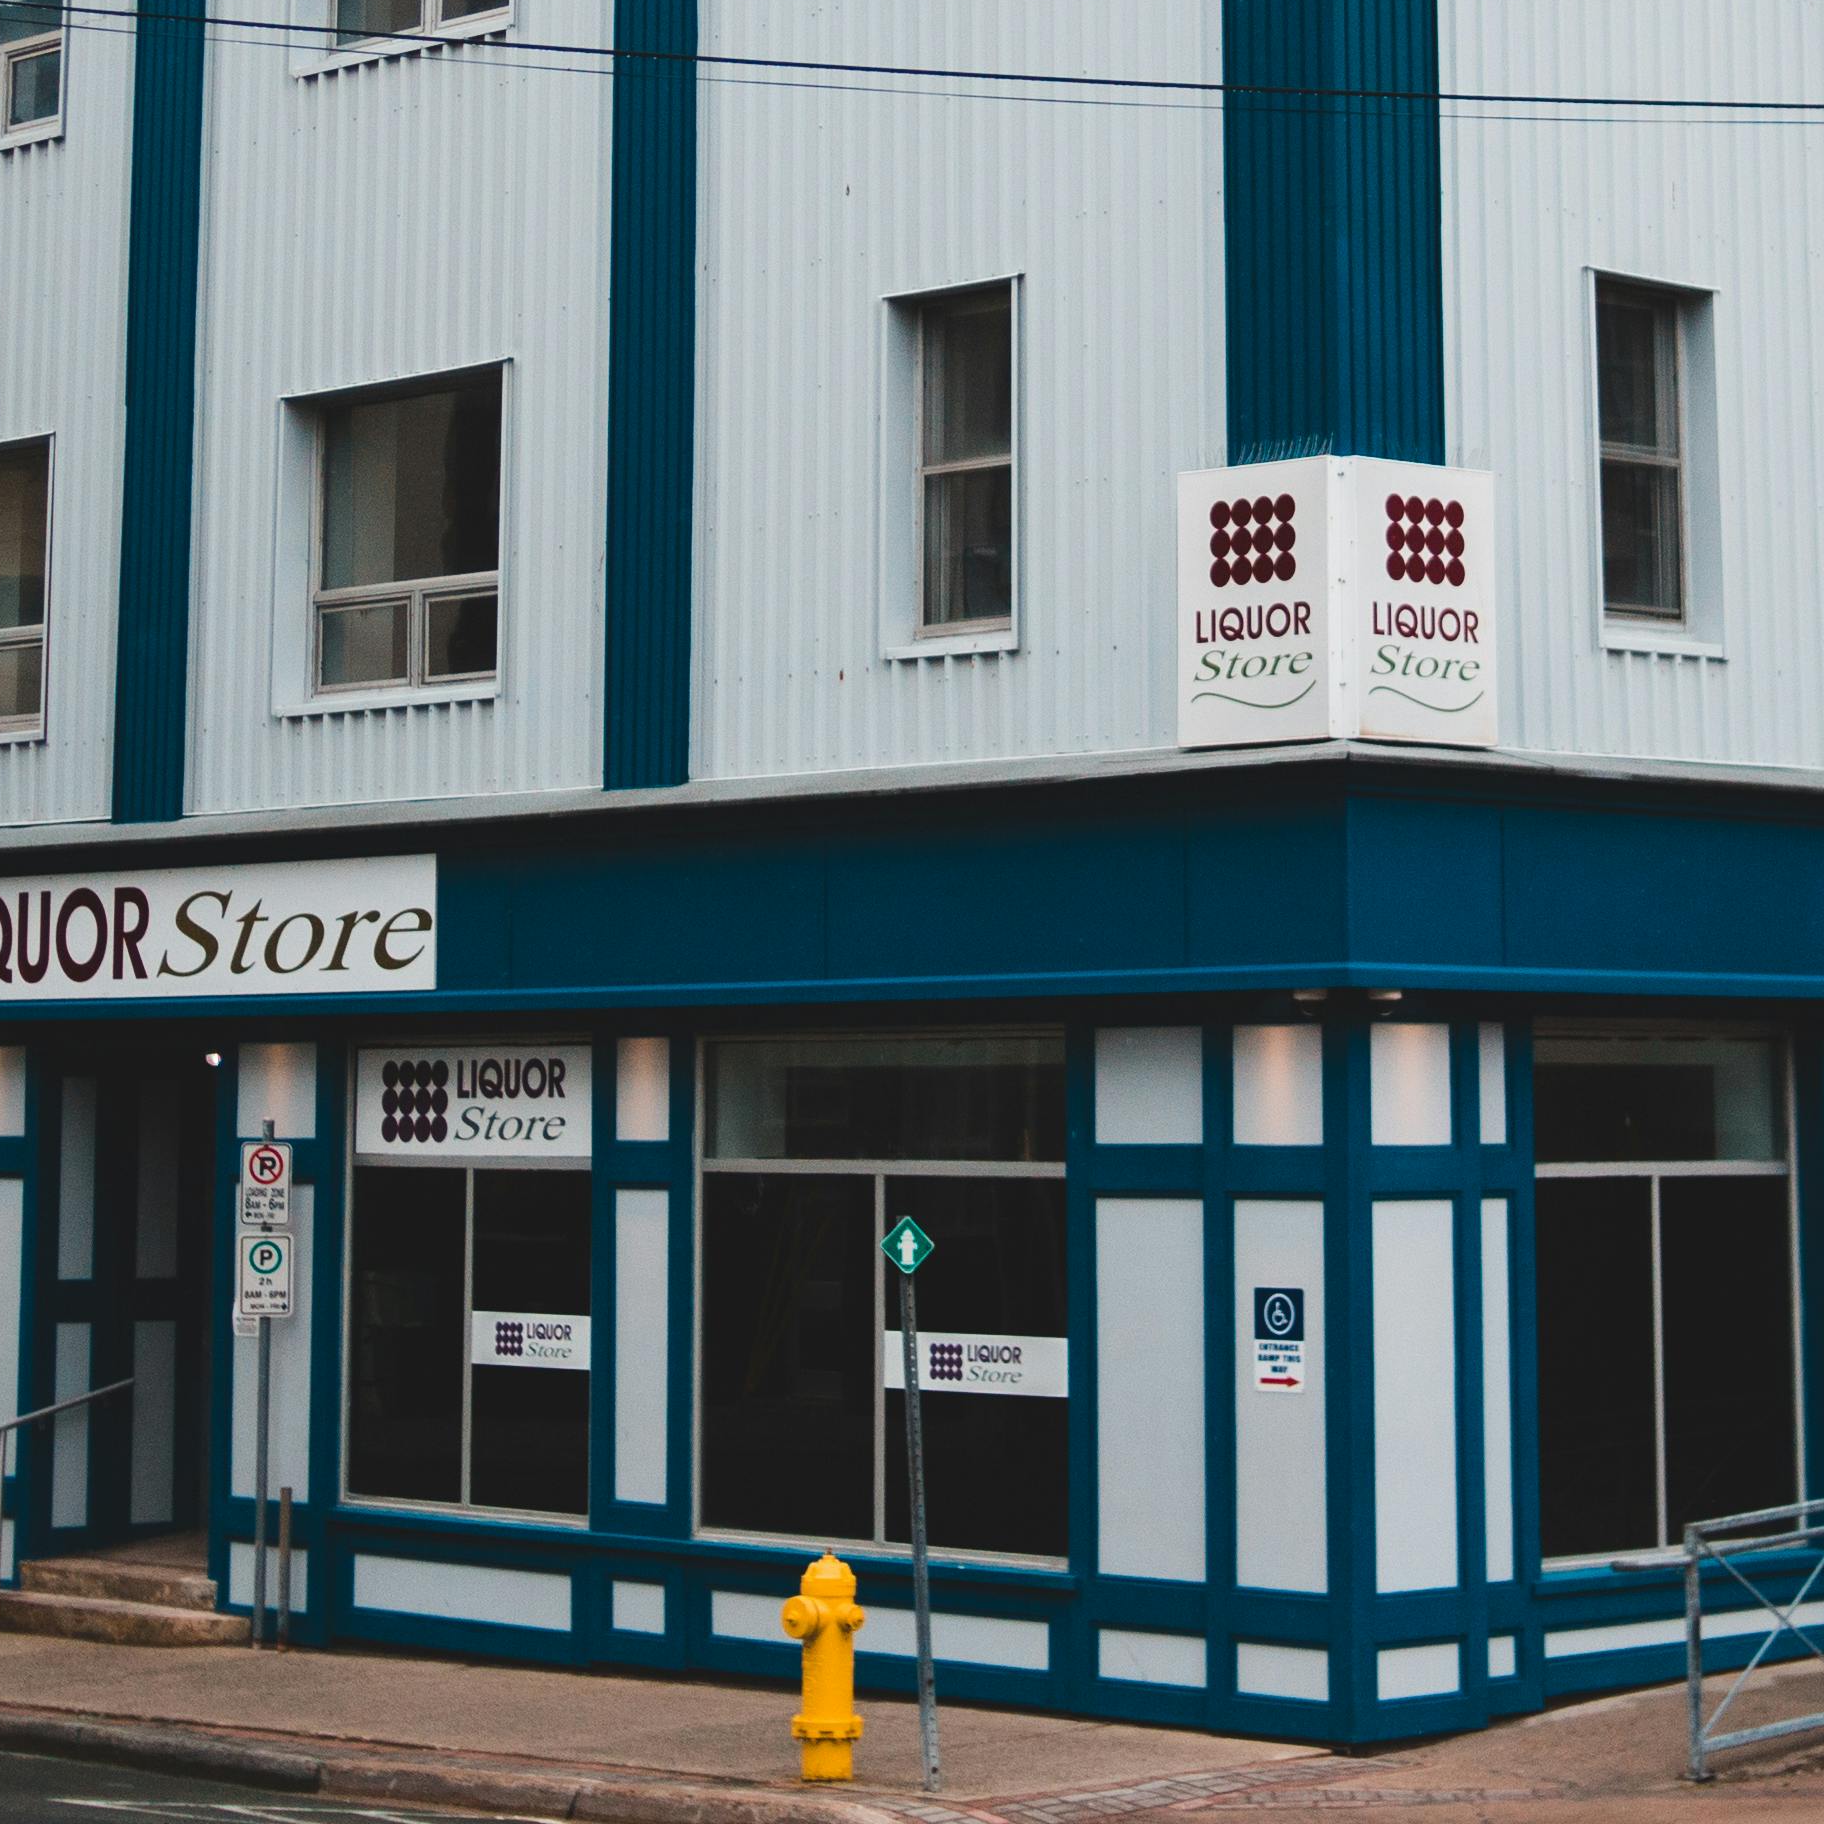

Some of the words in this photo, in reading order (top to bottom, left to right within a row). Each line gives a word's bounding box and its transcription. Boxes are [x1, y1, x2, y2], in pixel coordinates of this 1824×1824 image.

[1196, 601, 1311, 643] LIQUOR
[1372, 601, 1479, 643] LIQUOR
[1194, 649, 1313, 682] Store
[1370, 644, 1481, 681] Store
[156, 889, 433, 977] Store
[457, 1058, 566, 1099] LIQUOR
[453, 1106, 566, 1141] Store
[260, 1249, 273, 1266] P
[526, 1323, 572, 1341] LIQUOR
[526, 1342, 572, 1358] Store
[967, 1344, 1022, 1364] LIQUOR
[966, 1366, 1023, 1383] Store
